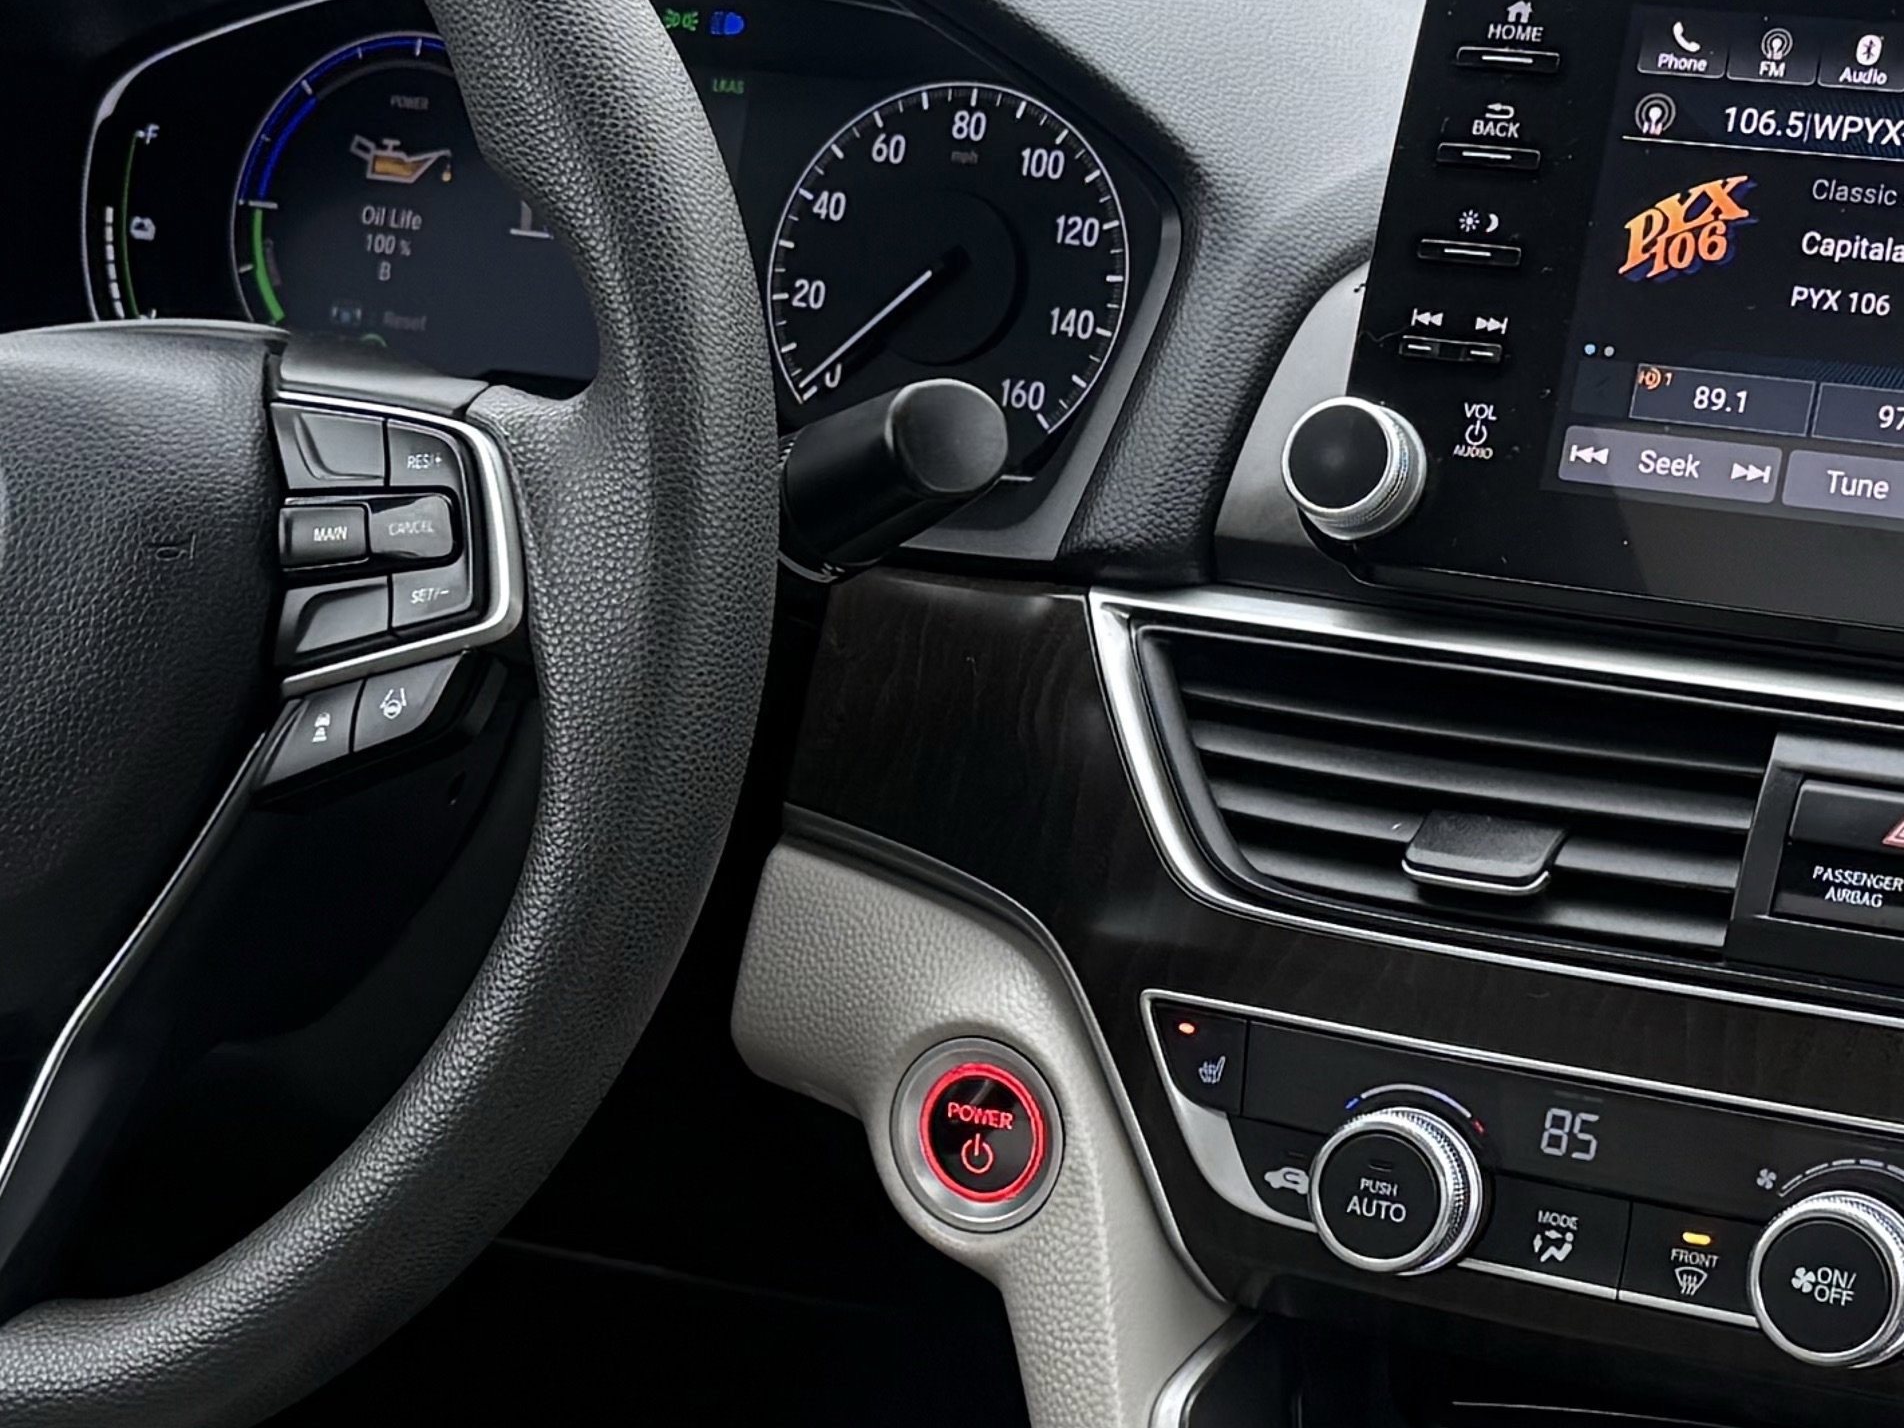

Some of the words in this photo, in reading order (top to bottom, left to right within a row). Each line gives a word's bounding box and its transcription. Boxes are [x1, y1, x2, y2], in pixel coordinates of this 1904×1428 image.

[1487, 22, 1544, 43] HOME
[1657, 52, 1708, 74] Phone
[1758, 60, 1786, 78] FM
[1839, 66, 1888, 86] Audio
[389, 94, 430, 111] POWER
[145, 123, 160, 145] F
[952, 113, 986, 141] 80
[1472, 119, 1520, 140] BACK
[1724, 106, 1805, 140] 106.5
[871, 134, 906, 164] 60
[1021, 148, 1064, 179] 100
[813, 191, 846, 221] 40
[1812, 179, 1898, 209] Classic
[361, 204, 386, 227] Oil
[390, 208, 423, 232] Life
[1056, 217, 1099, 247] 120
[1618, 174, 1751, 277] PYX
[366, 234, 396, 256] 100
[1645, 221, 1729, 281] 106
[792, 279, 826, 310] 20
[1791, 286, 1838, 313] PYX
[1846, 290, 1891, 318] 106
[1050, 307, 1094, 339] 140
[1001, 380, 1045, 411] 160
[1693, 385, 1748, 415] 89.1
[1463, 402, 1496, 422] VOL
[1452, 444, 1493, 460] AUDIO
[1637, 449, 1701, 482] Seek
[1826, 469, 1889, 501] Tune
[313, 526, 348, 542] MAIN
[389, 519, 434, 536] CANCEL
[1811, 864, 1904, 893] PASSENGER
[1824, 885, 1884, 909] AIRBAG
[947, 1101, 1014, 1130] POWER
[1540, 1106, 1601, 1162] 85
[1359, 1176, 1399, 1198] PUSH
[1346, 1193, 1407, 1225] AUTO
[1537, 1209, 1580, 1231] MODE
[1670, 1248, 1719, 1269] FRONT
[1816, 1266, 1857, 1288] ON/
[1814, 1283, 1855, 1307] OFF
